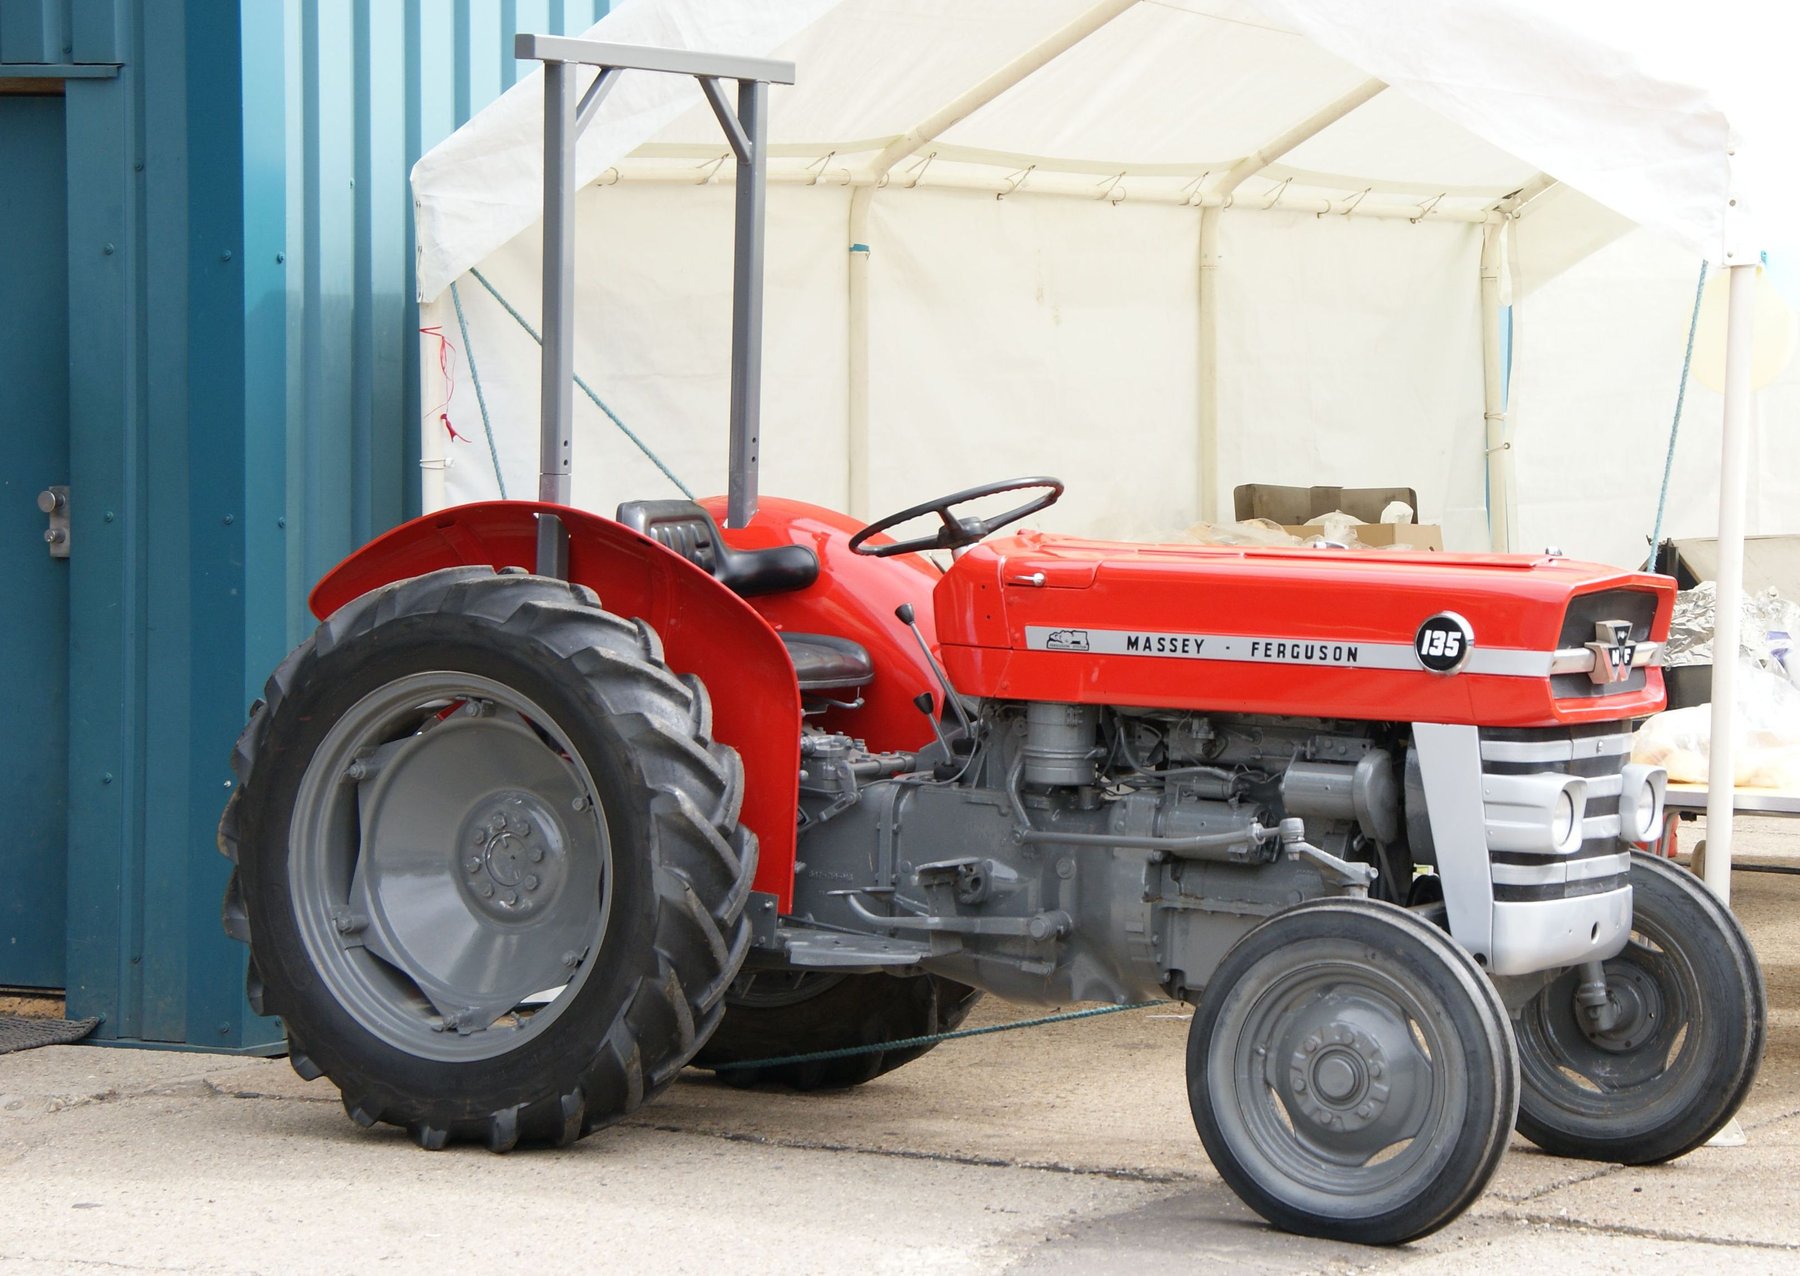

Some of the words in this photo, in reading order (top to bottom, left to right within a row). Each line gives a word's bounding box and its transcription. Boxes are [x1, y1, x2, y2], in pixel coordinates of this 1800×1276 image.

[1127, 635, 1204, 654] MASSEY
[1251, 642, 1358, 662] FERGUSON
[1421, 630, 1461, 657] 135
